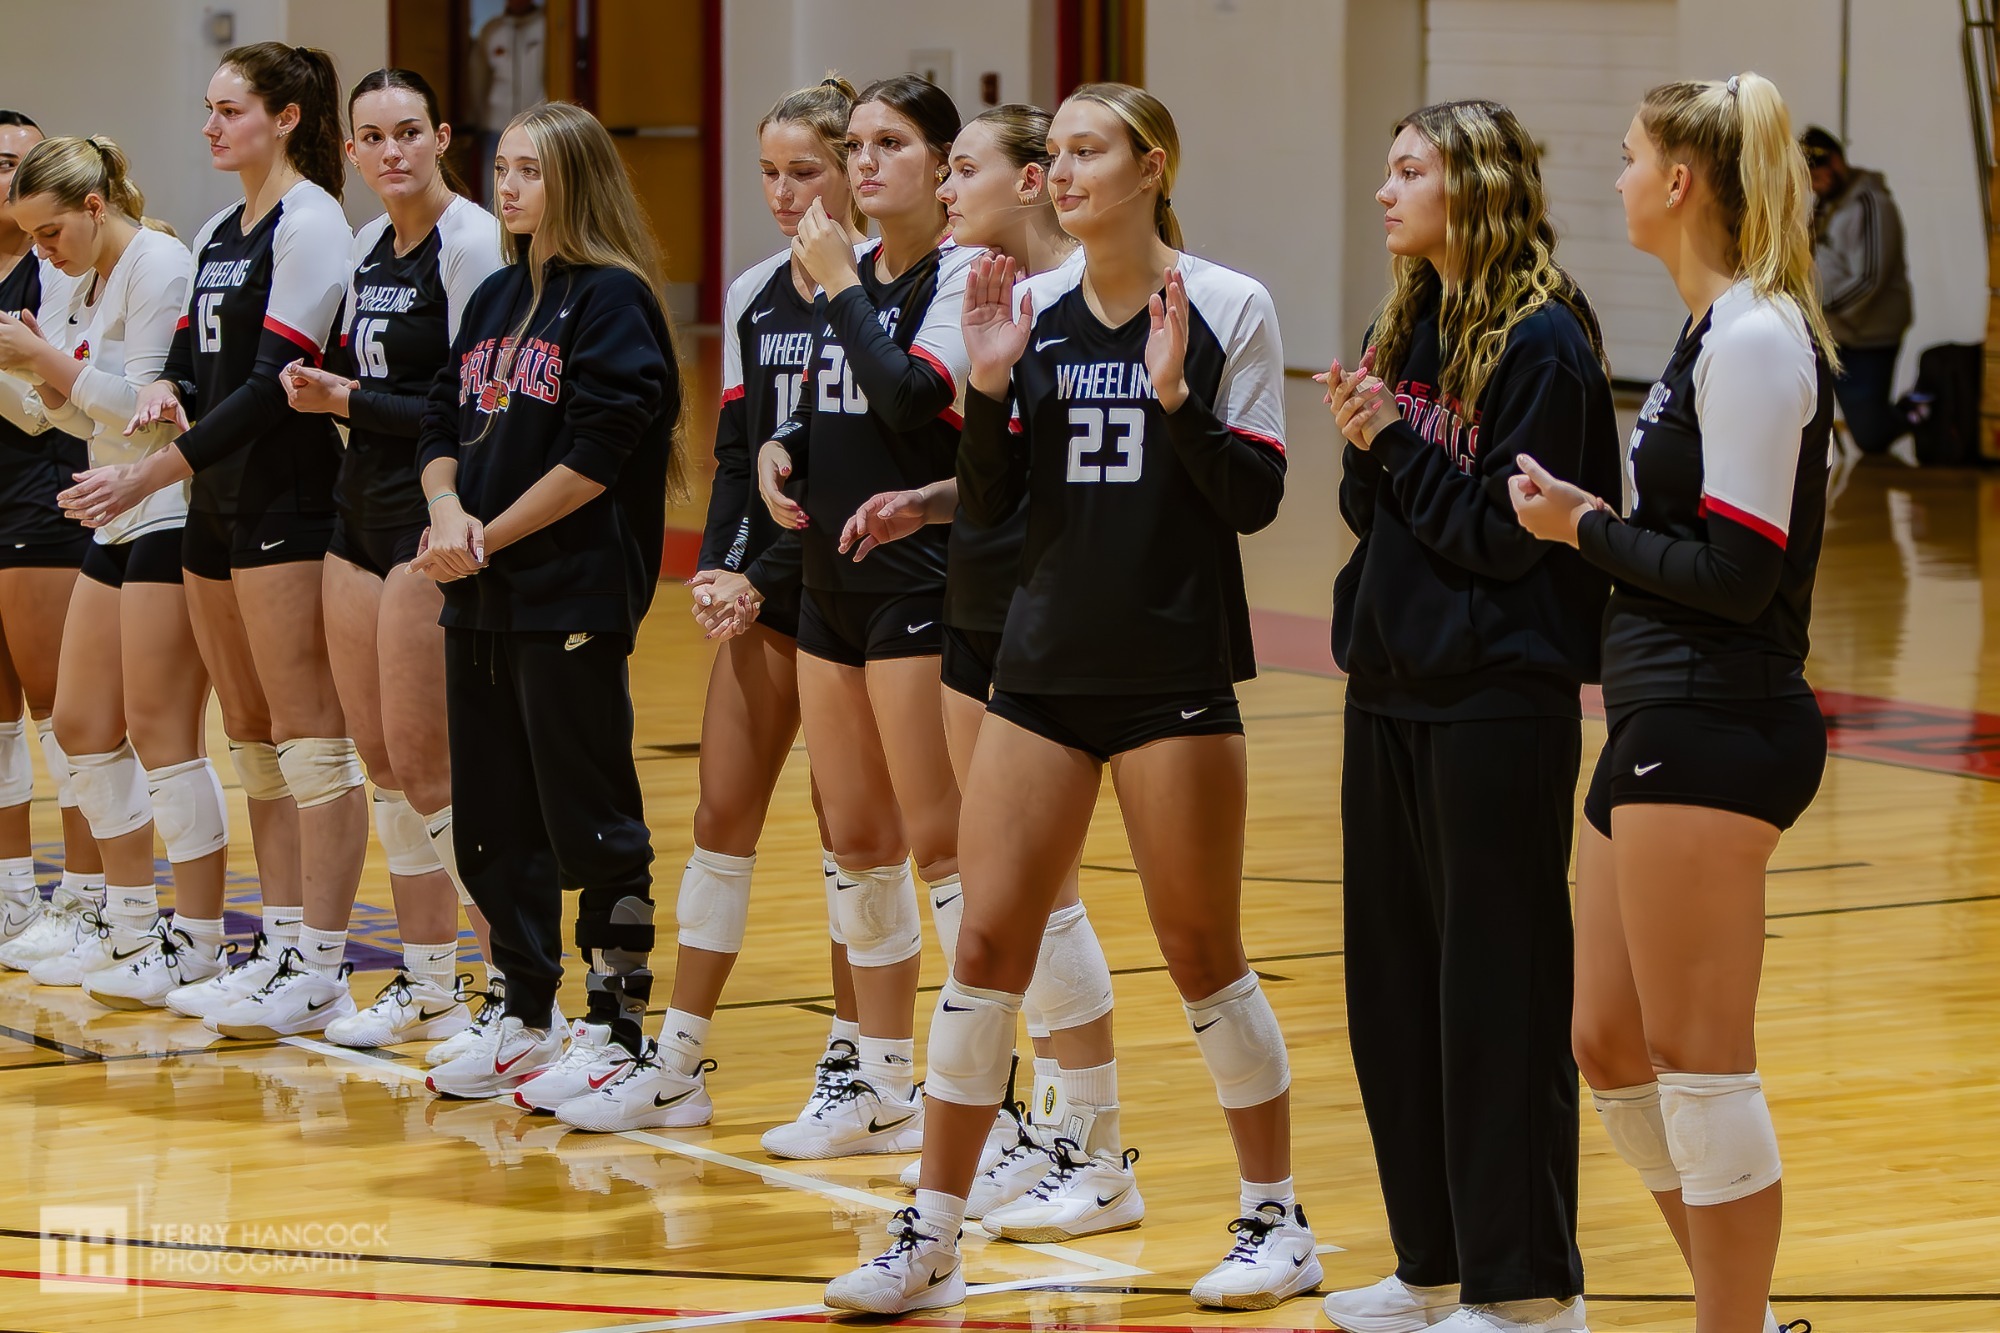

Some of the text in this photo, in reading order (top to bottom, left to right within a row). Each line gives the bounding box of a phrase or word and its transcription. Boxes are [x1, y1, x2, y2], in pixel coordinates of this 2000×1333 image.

[196, 259, 251, 288] WHEELING
[357, 285, 417, 313] WHEELING
[198, 293, 224, 352] 15
[355, 318, 389, 378] 16
[760, 333, 813, 365] WHEEL
[1056, 362, 1160, 400] WHEELIN
[1067, 408, 1145, 482] 23
